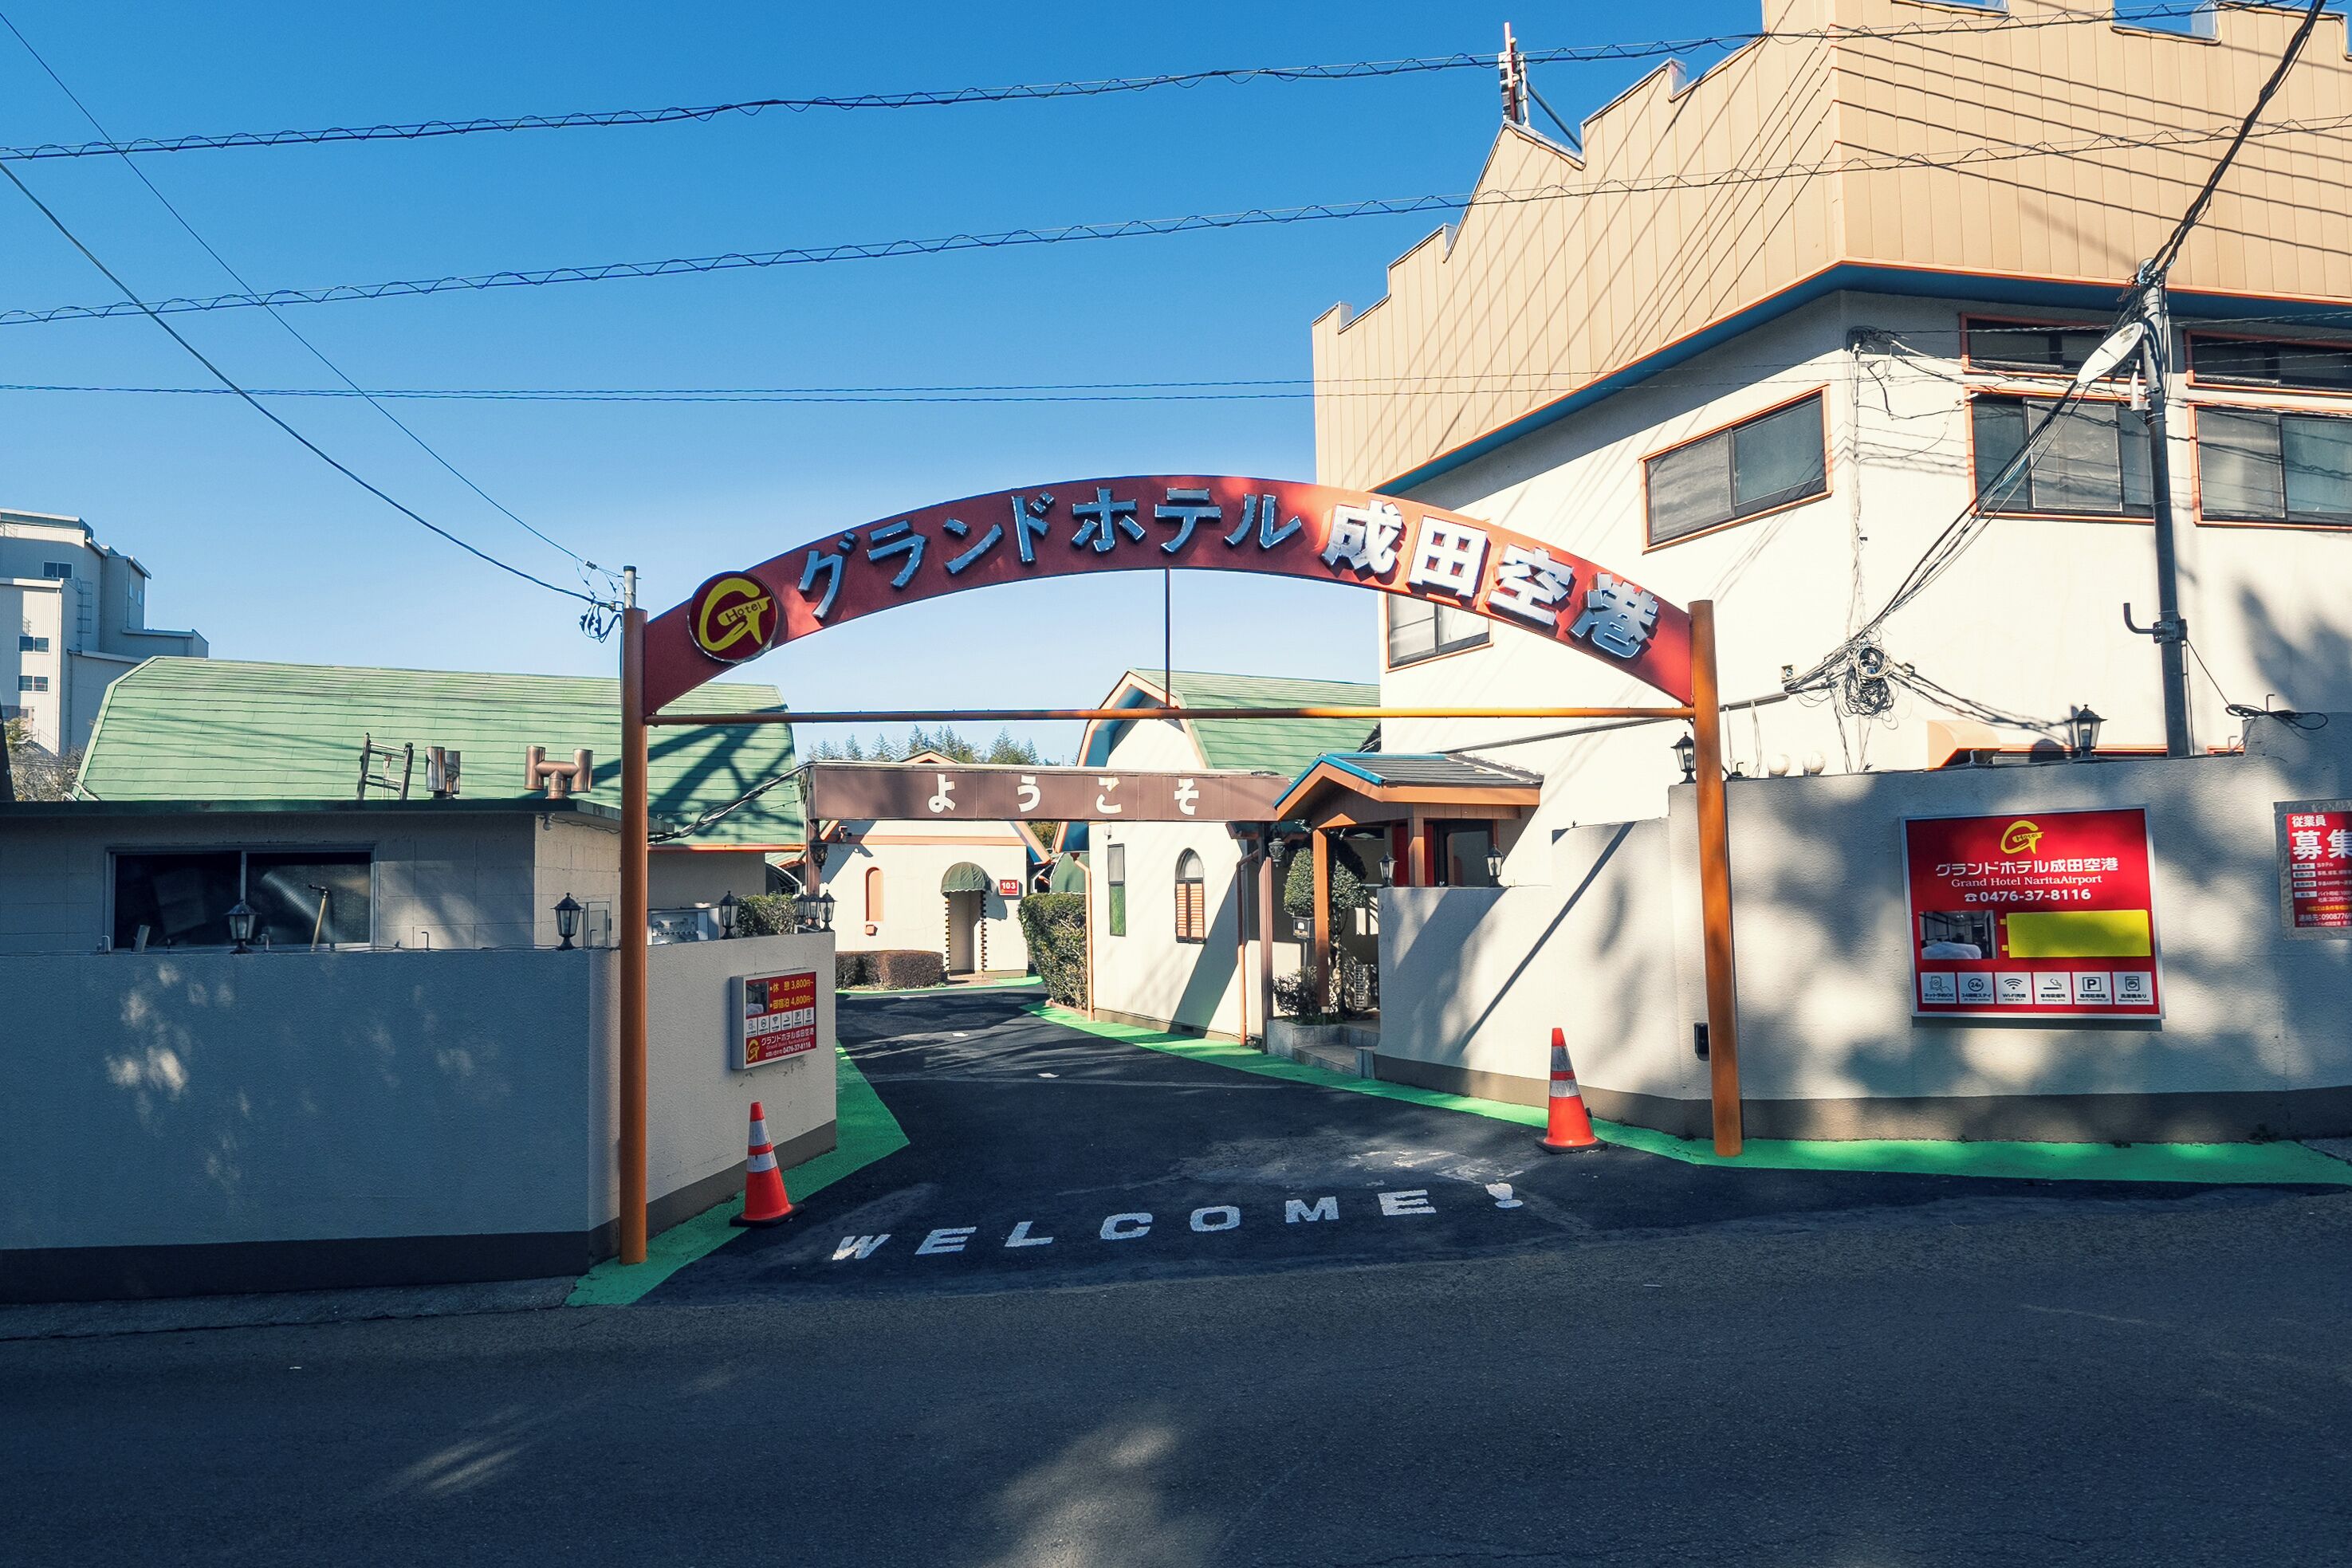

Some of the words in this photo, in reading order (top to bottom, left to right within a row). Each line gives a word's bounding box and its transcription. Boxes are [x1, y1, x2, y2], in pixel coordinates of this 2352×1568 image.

[796, 486, 1659, 659] グランドホテル成田空港
[725, 601, 763, 623] Hotel
[927, 773, 1200, 815] ようこそ
[2291, 815, 2326, 827] 従業員
[2016, 833, 2039, 842] Hotel
[2291, 828, 2352, 861] 募集
[1935, 857, 2118, 877] グランドホテル成田空港
[1952, 878, 1987, 888] Grand
[1990, 876, 2021, 886] Hotel
[2024, 874, 2102, 887] NaritaAirport
[1979, 889, 2091, 902] 0476-37-8116
